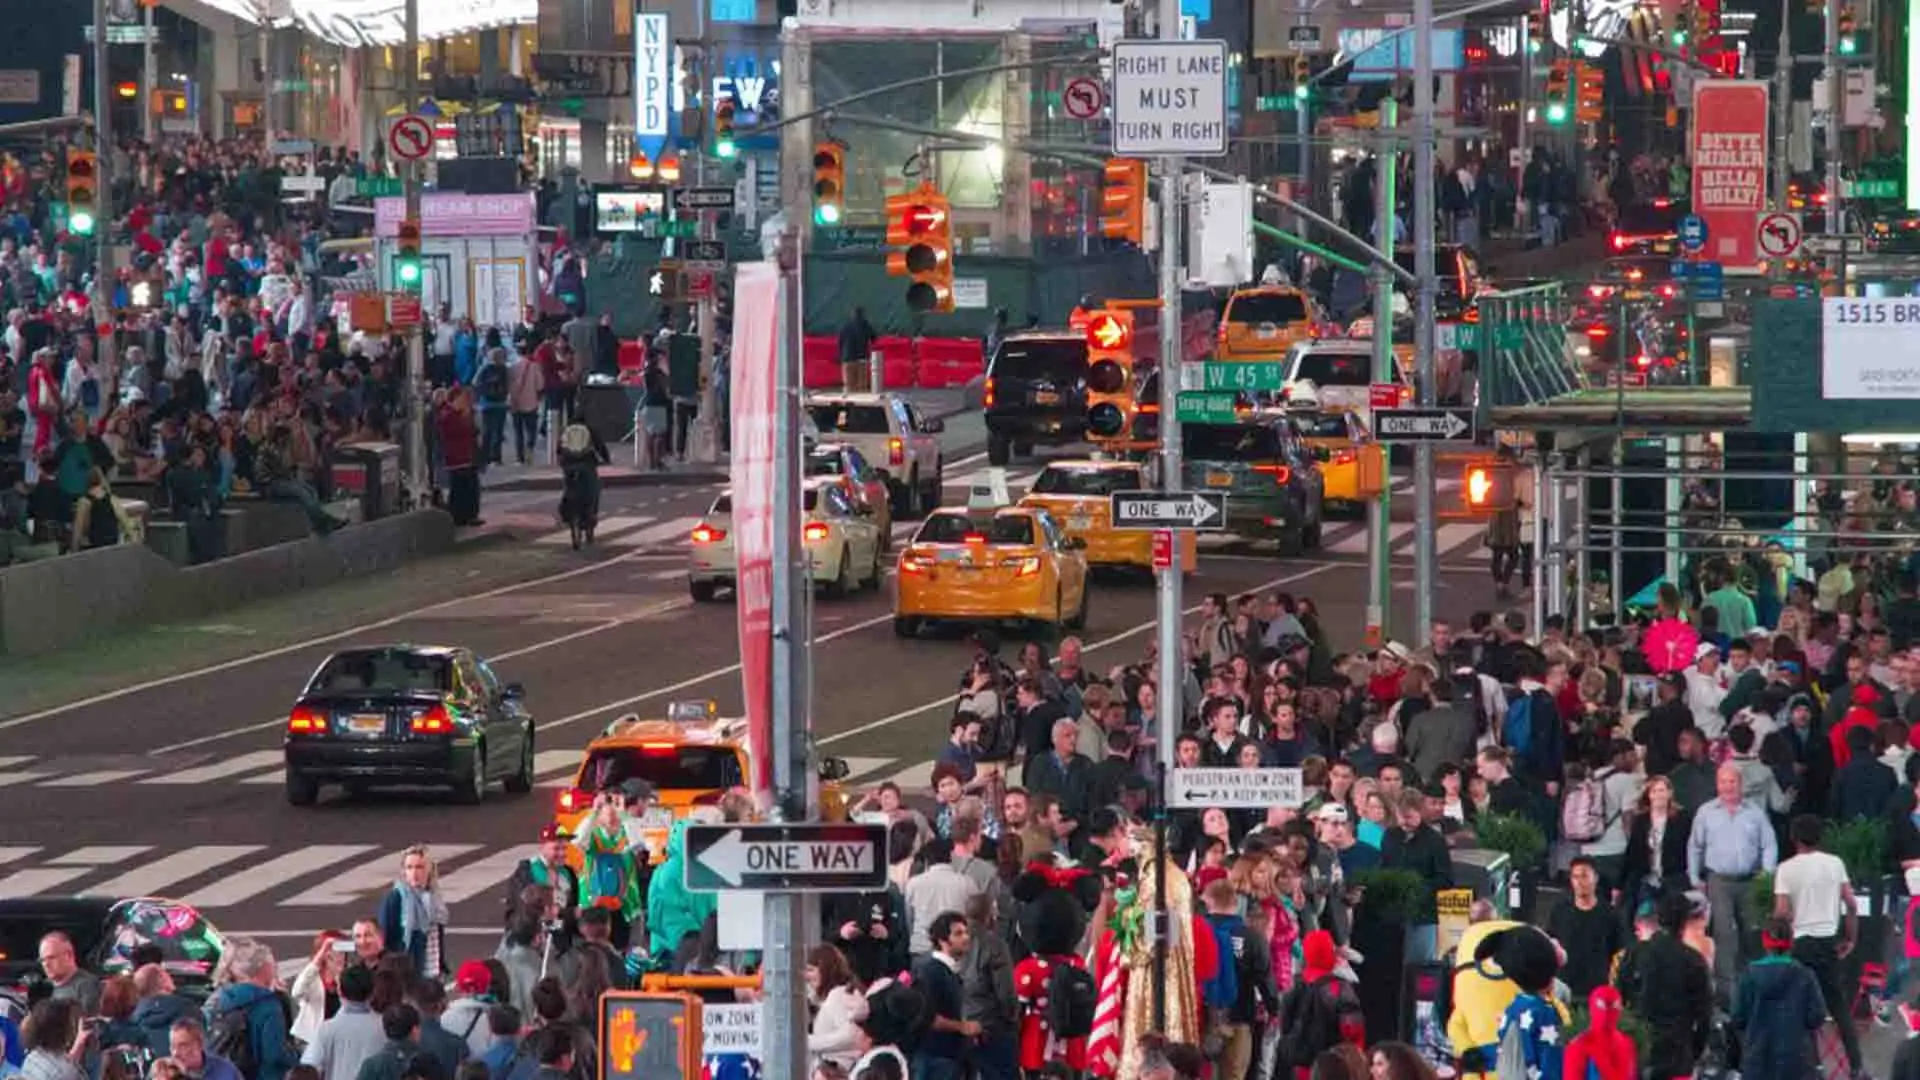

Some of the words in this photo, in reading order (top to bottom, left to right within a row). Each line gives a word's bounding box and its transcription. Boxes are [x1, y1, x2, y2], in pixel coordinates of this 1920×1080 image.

[1117, 56, 1166, 74] RIGHT
[1177, 56, 1222, 74] LANE
[645, 18, 660, 130] NYPD
[1139, 87, 1201, 109] MUST
[1118, 121, 1162, 139] TURN
[1172, 121, 1222, 139] RIGHT
[1701, 133, 1761, 149] BETTE
[1698, 150, 1764, 167] MIDLER
[1702, 188, 1758, 205] DOLLY!
[479, 200, 523, 216] SHOP
[1836, 303, 1887, 323] 1515
[1208, 366, 1225, 387] W
[1234, 366, 1257, 387] 45
[1388, 418, 1417, 431] ONE
[1429, 418, 1459, 431] WAY
[1128, 503, 1160, 517] ONE
[1174, 503, 1207, 517] WAY
[1182, 773, 1241, 786] PEDESTRIAN
[1271, 773, 1296, 786] ZONE
[1259, 788, 1297, 801] MOVING
[746, 845, 799, 869] ONE
[810, 845, 866, 869] WAY
[727, 1011, 759, 1026] ZONE
[713, 1031, 759, 1046] MOVING
